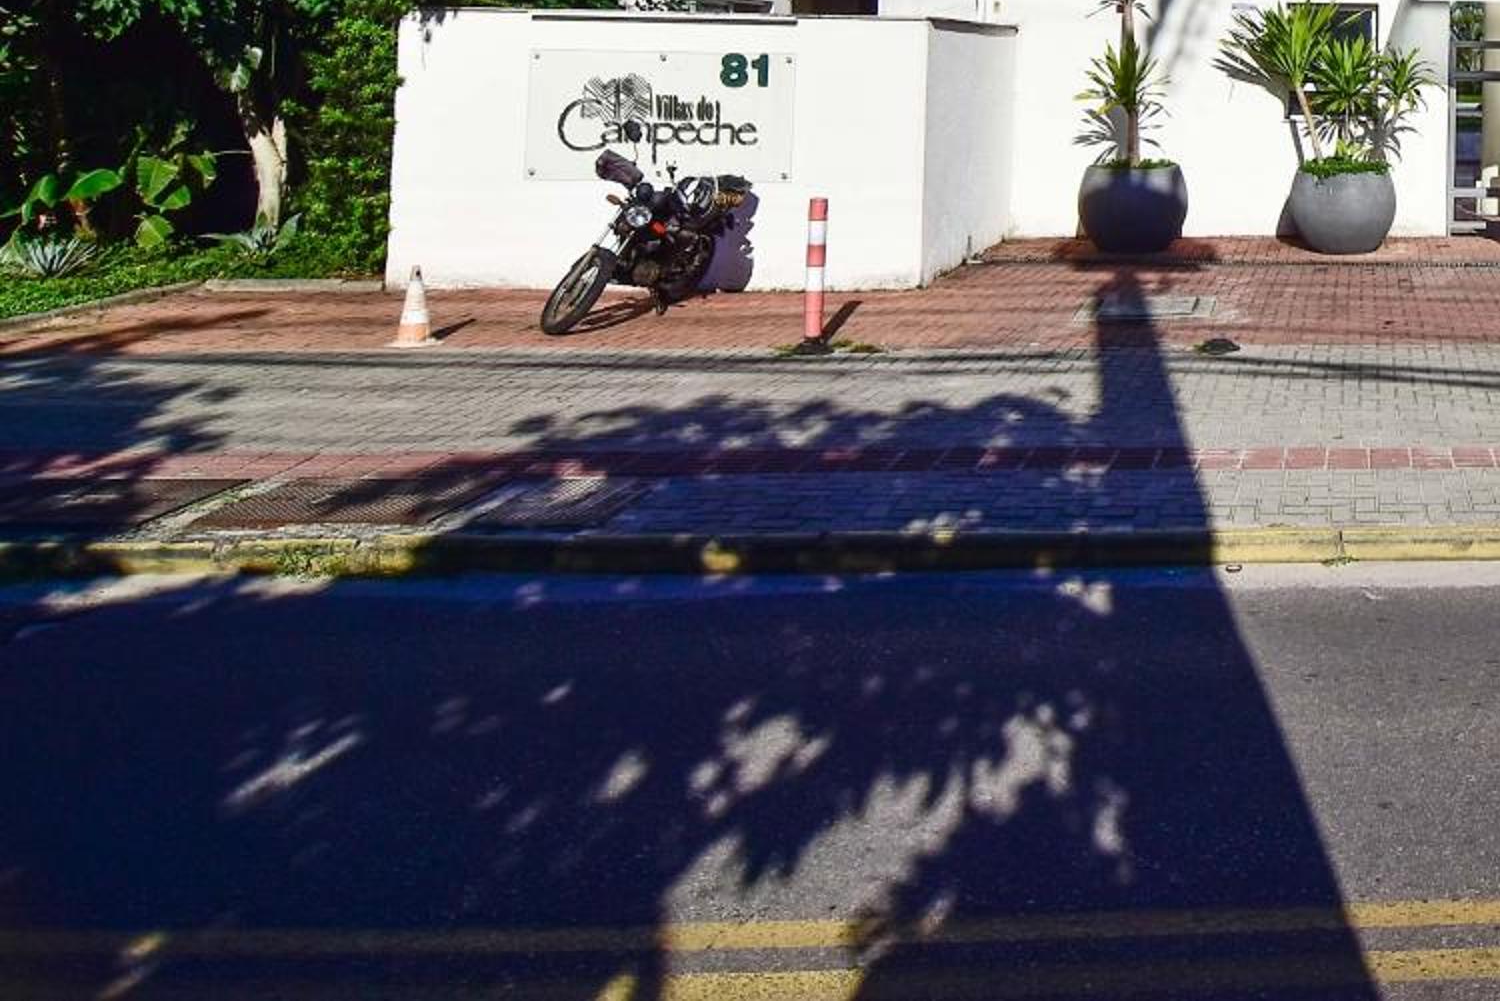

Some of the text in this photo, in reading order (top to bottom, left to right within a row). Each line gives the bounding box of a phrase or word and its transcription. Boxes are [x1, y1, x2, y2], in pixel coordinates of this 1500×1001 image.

[720, 52, 769, 87] 81
[656, 95, 714, 121] Villas do
